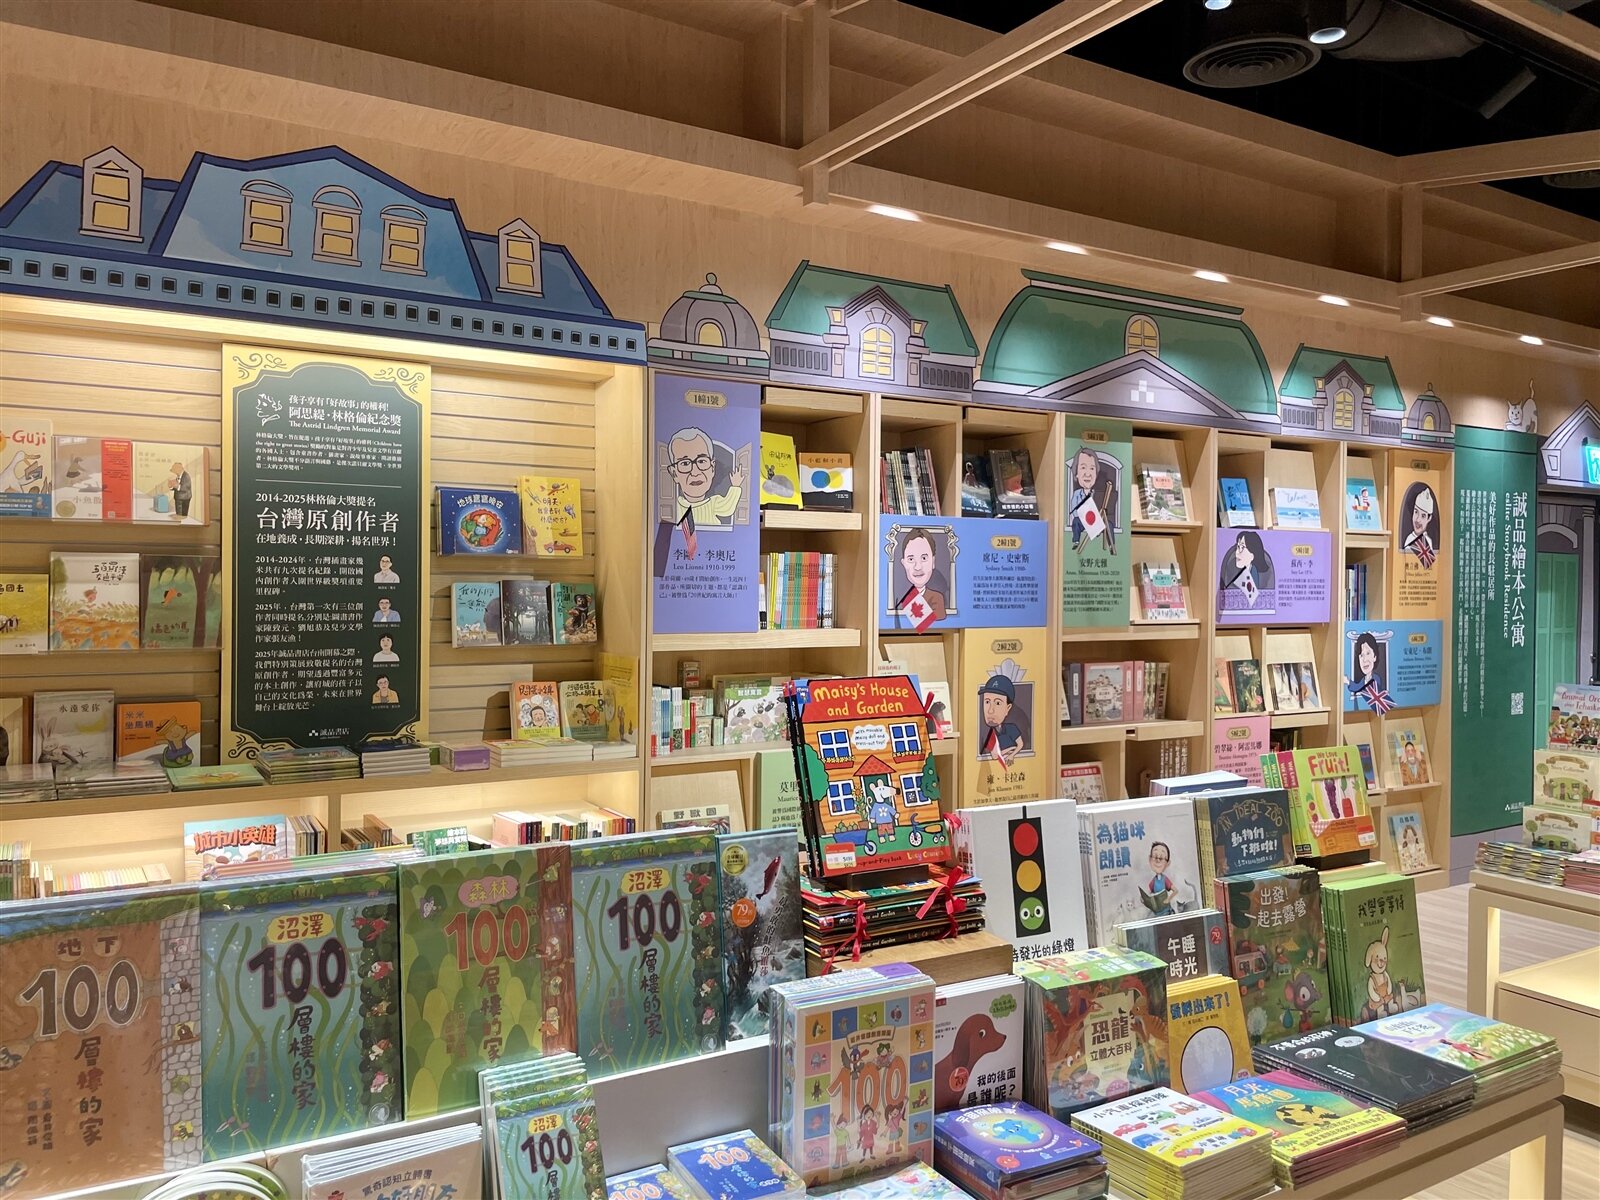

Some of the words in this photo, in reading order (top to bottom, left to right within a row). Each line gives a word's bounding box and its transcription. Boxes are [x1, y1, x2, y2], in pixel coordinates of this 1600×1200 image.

[694, 394, 719, 406] 1幢1號
[289, 420, 301, 428] The
[302, 422, 321, 430] Astrid
[323, 424, 351, 432] Lindgren
[352, 426, 380, 434] Memorial
[256, 492, 376, 507] 2014-2025林格倫大獎提名
[257, 508, 400, 532] 台灣原創作者
[1488, 492, 1496, 600] 美好作品的長駐居所
[1503, 524, 1512, 580] Storybook
[1512, 492, 1528, 648] 誠品繪本公寓
[814, 684, 866, 702] Maisy's
[871, 683, 909, 698] House
[59, 704, 100, 713] 永遠愛你
[828, 704, 848, 717] and
[856, 701, 904, 715] Garden
[125, 720, 154, 730] 坐馬桶
[320, 728, 350, 736] 誠品書店
[1308, 752, 1350, 777] Fruit!
[1235, 804, 1262, 820] IDEAL
[1264, 806, 1282, 827] ZOO
[194, 824, 277, 854] 城市小英雄
[1097, 821, 1146, 844] 為貓咪
[1232, 826, 1264, 847] 動物們
[1099, 847, 1132, 870] 朗讀
[468, 880, 510, 903] 森林
[628, 870, 664, 892] 沼澤
[1260, 887, 1289, 904] 出發!
[1358, 894, 1404, 918] 我學會等待
[608, 890, 682, 951] 100
[880, 910, 896, 918] Garden
[1244, 898, 1307, 928] 一起去露營
[278, 914, 324, 941] 沼澤
[444, 905, 530, 972] 100
[58, 936, 118, 957] 地下
[1167, 934, 1196, 956] 午睡
[247, 938, 347, 1010] 100
[1169, 956, 1198, 978] 時光
[19, 959, 141, 1037] 100
[640, 948, 662, 1038] 層樓的家
[478, 966, 502, 1063] 層樓的家
[1170, 992, 1230, 1020] 蛋孵出來了!
[1091, 1016, 1129, 1045] 恐龍
[287, 1005, 317, 1110] 層樓的家
[1090, 1044, 1132, 1061] 立體大百科
[977, 1068, 1016, 1088] 我的後面
[1223, 1082, 1270, 1097] 月光
[75, 1036, 104, 1147] 層樓的家
[826, 1055, 908, 1126] 100
[533, 1117, 558, 1131] 沼澤
[520, 1128, 572, 1174] 100
[700, 1146, 750, 1170] 100
[362, 1169, 432, 1197] 驚奇認知立體書
